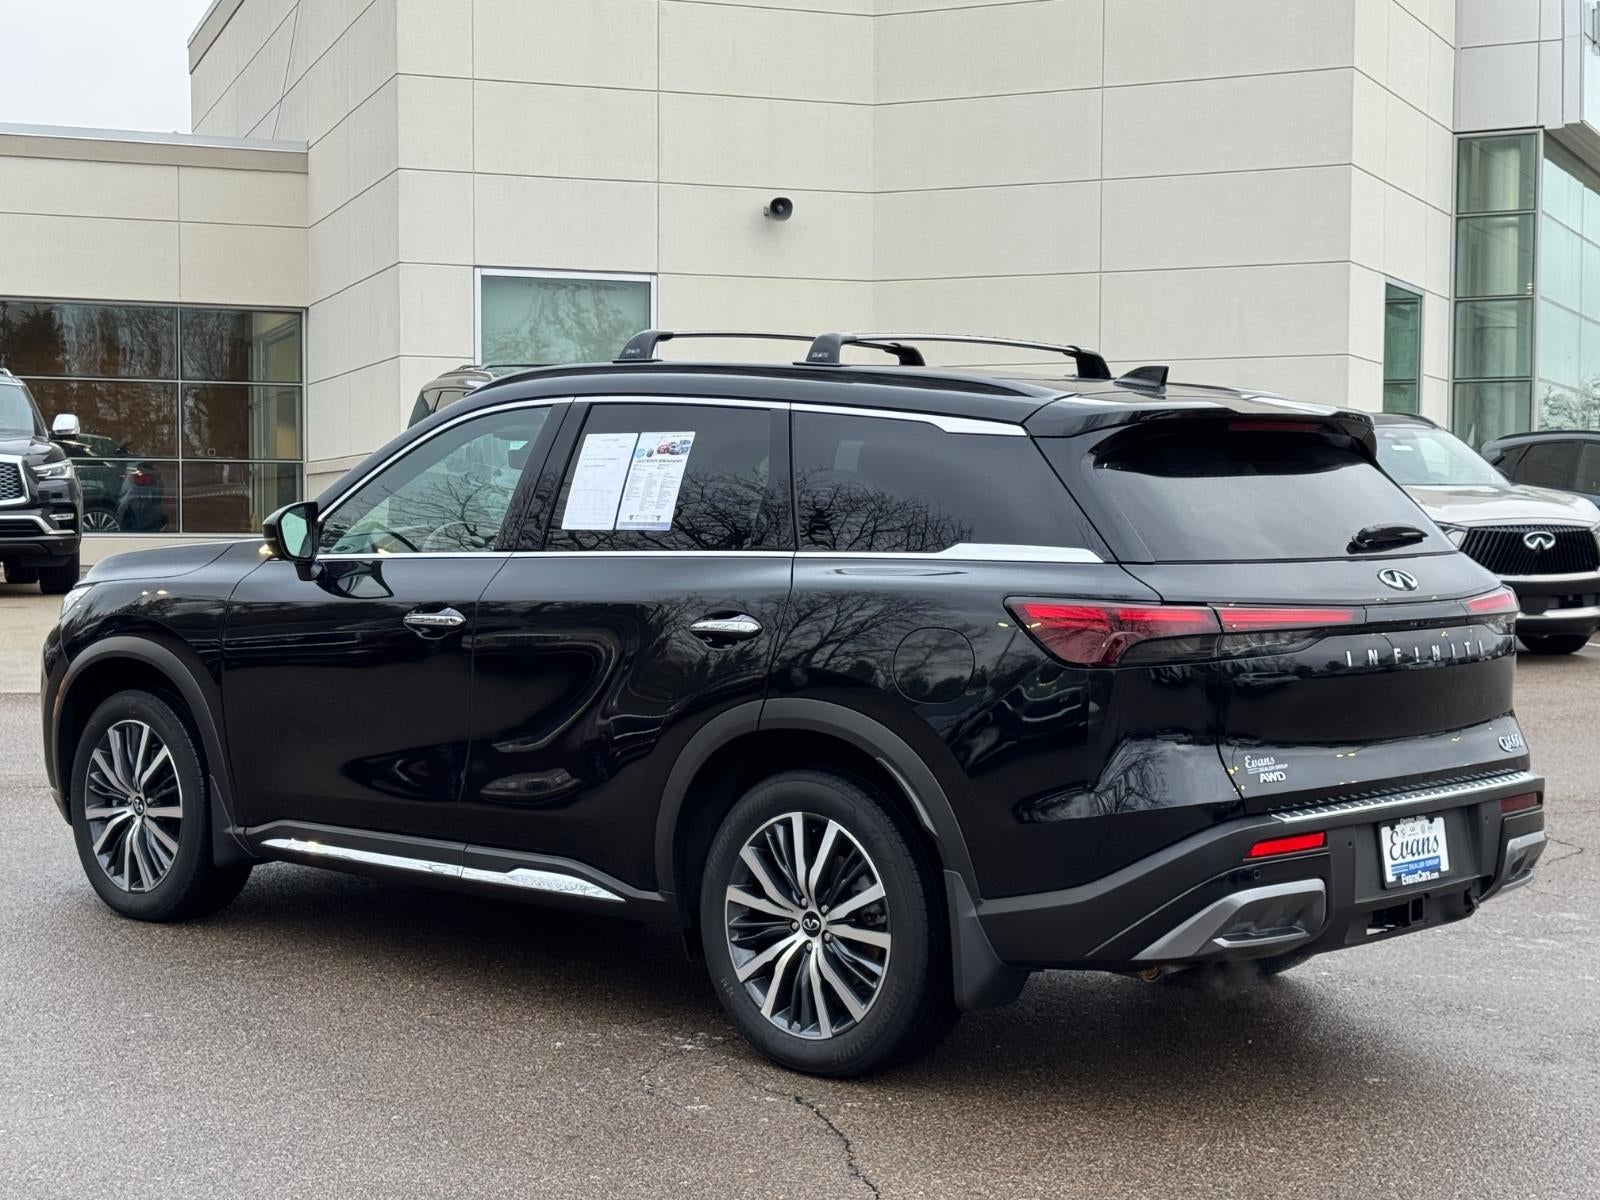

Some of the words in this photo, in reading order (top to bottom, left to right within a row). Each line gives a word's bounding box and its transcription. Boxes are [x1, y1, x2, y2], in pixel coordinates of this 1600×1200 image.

[1346, 640, 1485, 667] INFINITI
[1244, 755, 1275, 768] Evans
[1259, 771, 1286, 783] AWD
[1390, 830, 1439, 861] Evans
